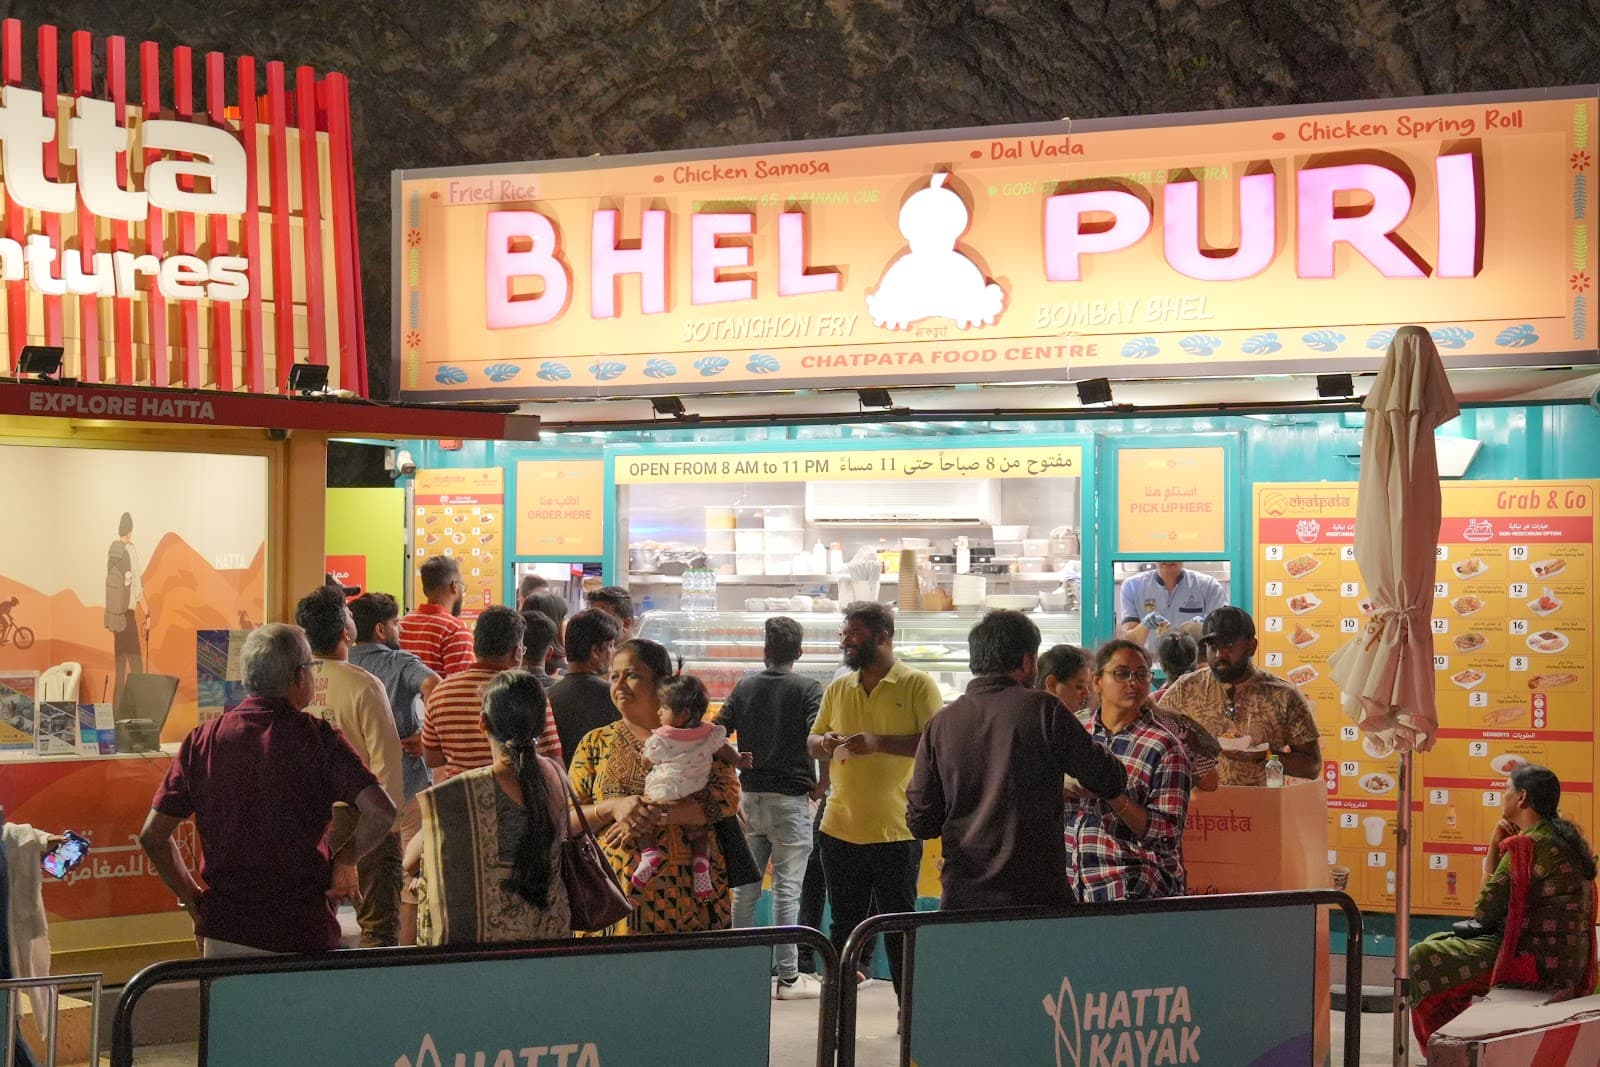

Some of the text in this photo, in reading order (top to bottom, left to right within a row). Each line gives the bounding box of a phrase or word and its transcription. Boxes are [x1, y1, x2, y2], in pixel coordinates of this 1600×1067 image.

[1298, 109, 1523, 142] Chicken Spring Roll
[990, 137, 1084, 161] Dal Vada
[672, 158, 831, 185] Chicken Samosa
[448, 180, 537, 203] Fried Rice
[485, 149, 1486, 331] BHEL PURI
[1035, 295, 1215, 330] BOMBAY BHEL
[679, 312, 858, 342] SOTANGHON FRY
[800, 343, 1099, 369] CHATPATA FOOD CENTRE
[28, 390, 216, 421] EXPLORE HATTA
[629, 459, 830, 477] OPEN FROM 8 AM to 11 PM
[880, 457, 896, 471] 11
[903, 458, 933, 475] حتى
[985, 456, 995, 470] 8
[999, 456, 1020, 474] من
[1027, 453, 1073, 475] مفتوح
[1288, 493, 1350, 513] chatpata
[1497, 489, 1587, 511] Grab & Go
[1130, 501, 1213, 514] PICK UP HERE
[527, 509, 592, 521] ORDER HERE
[1271, 547, 1277, 556] 9
[1346, 547, 1353, 556] 6
[1513, 547, 1524, 556] 10
[1271, 583, 1277, 592] 7
[1346, 583, 1353, 593] 8
[1434, 584, 1444, 593] 12
[1513, 584, 1523, 593] 12
[1343, 619, 1355, 628] 10
[1434, 620, 1444, 629] 12
[1513, 621, 1524, 630] 16
[1271, 654, 1277, 663] 7
[1434, 656, 1445, 665] 10
[1515, 658, 1522, 667] 8
[1475, 693, 1481, 702] 3
[1343, 727, 1354, 736] 16
[1475, 743, 1482, 752] 9
[1343, 762, 1355, 772] 10
[1436, 791, 1442, 800] 3
[1488, 792, 1495, 802] 3
[1185, 809, 1253, 841] atpata
[1346, 815, 1352, 824] 3
[1436, 855, 1442, 865] 3
[41, 853, 144, 887] للمغامر
[1083, 986, 1192, 1031] HATTA
[1088, 1025, 1201, 1067] KAYAK
